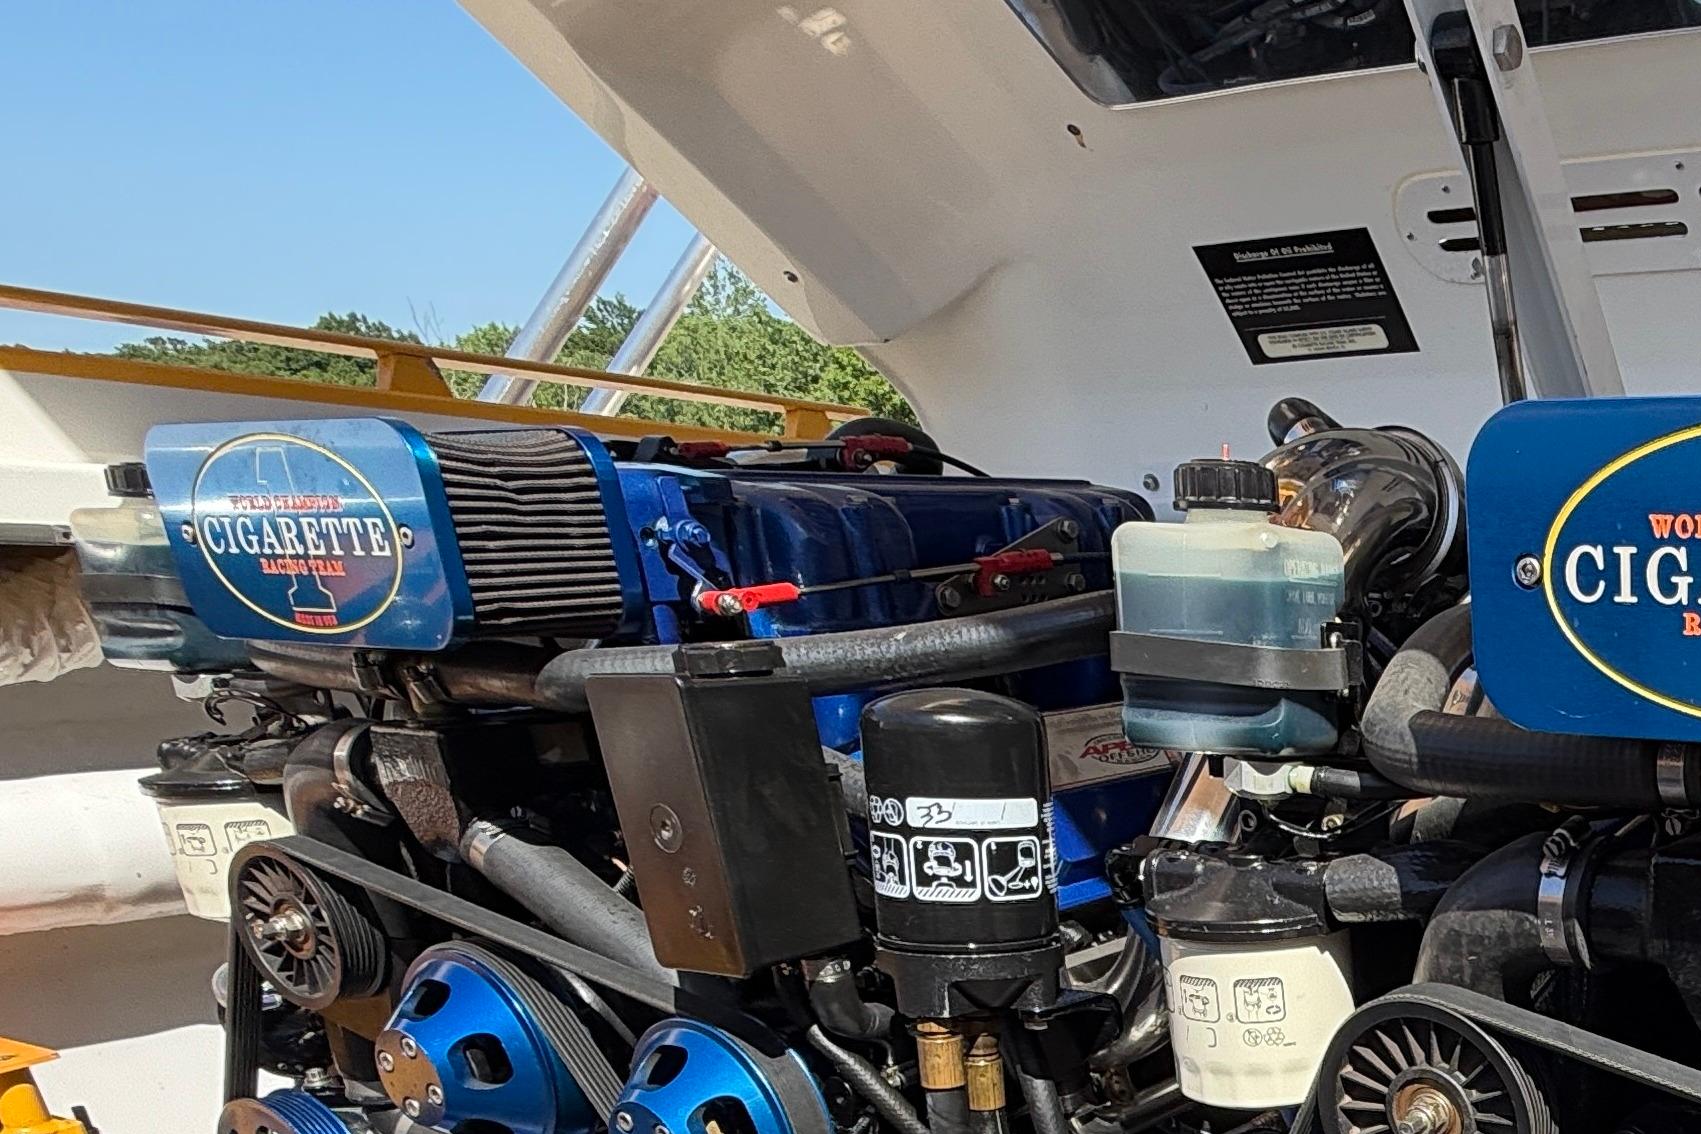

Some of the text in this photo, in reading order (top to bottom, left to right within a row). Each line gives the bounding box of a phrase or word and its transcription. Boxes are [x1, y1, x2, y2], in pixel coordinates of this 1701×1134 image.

[203, 515, 391, 557] CIGARETTE
[259, 557, 346, 577] RACING TEAM
